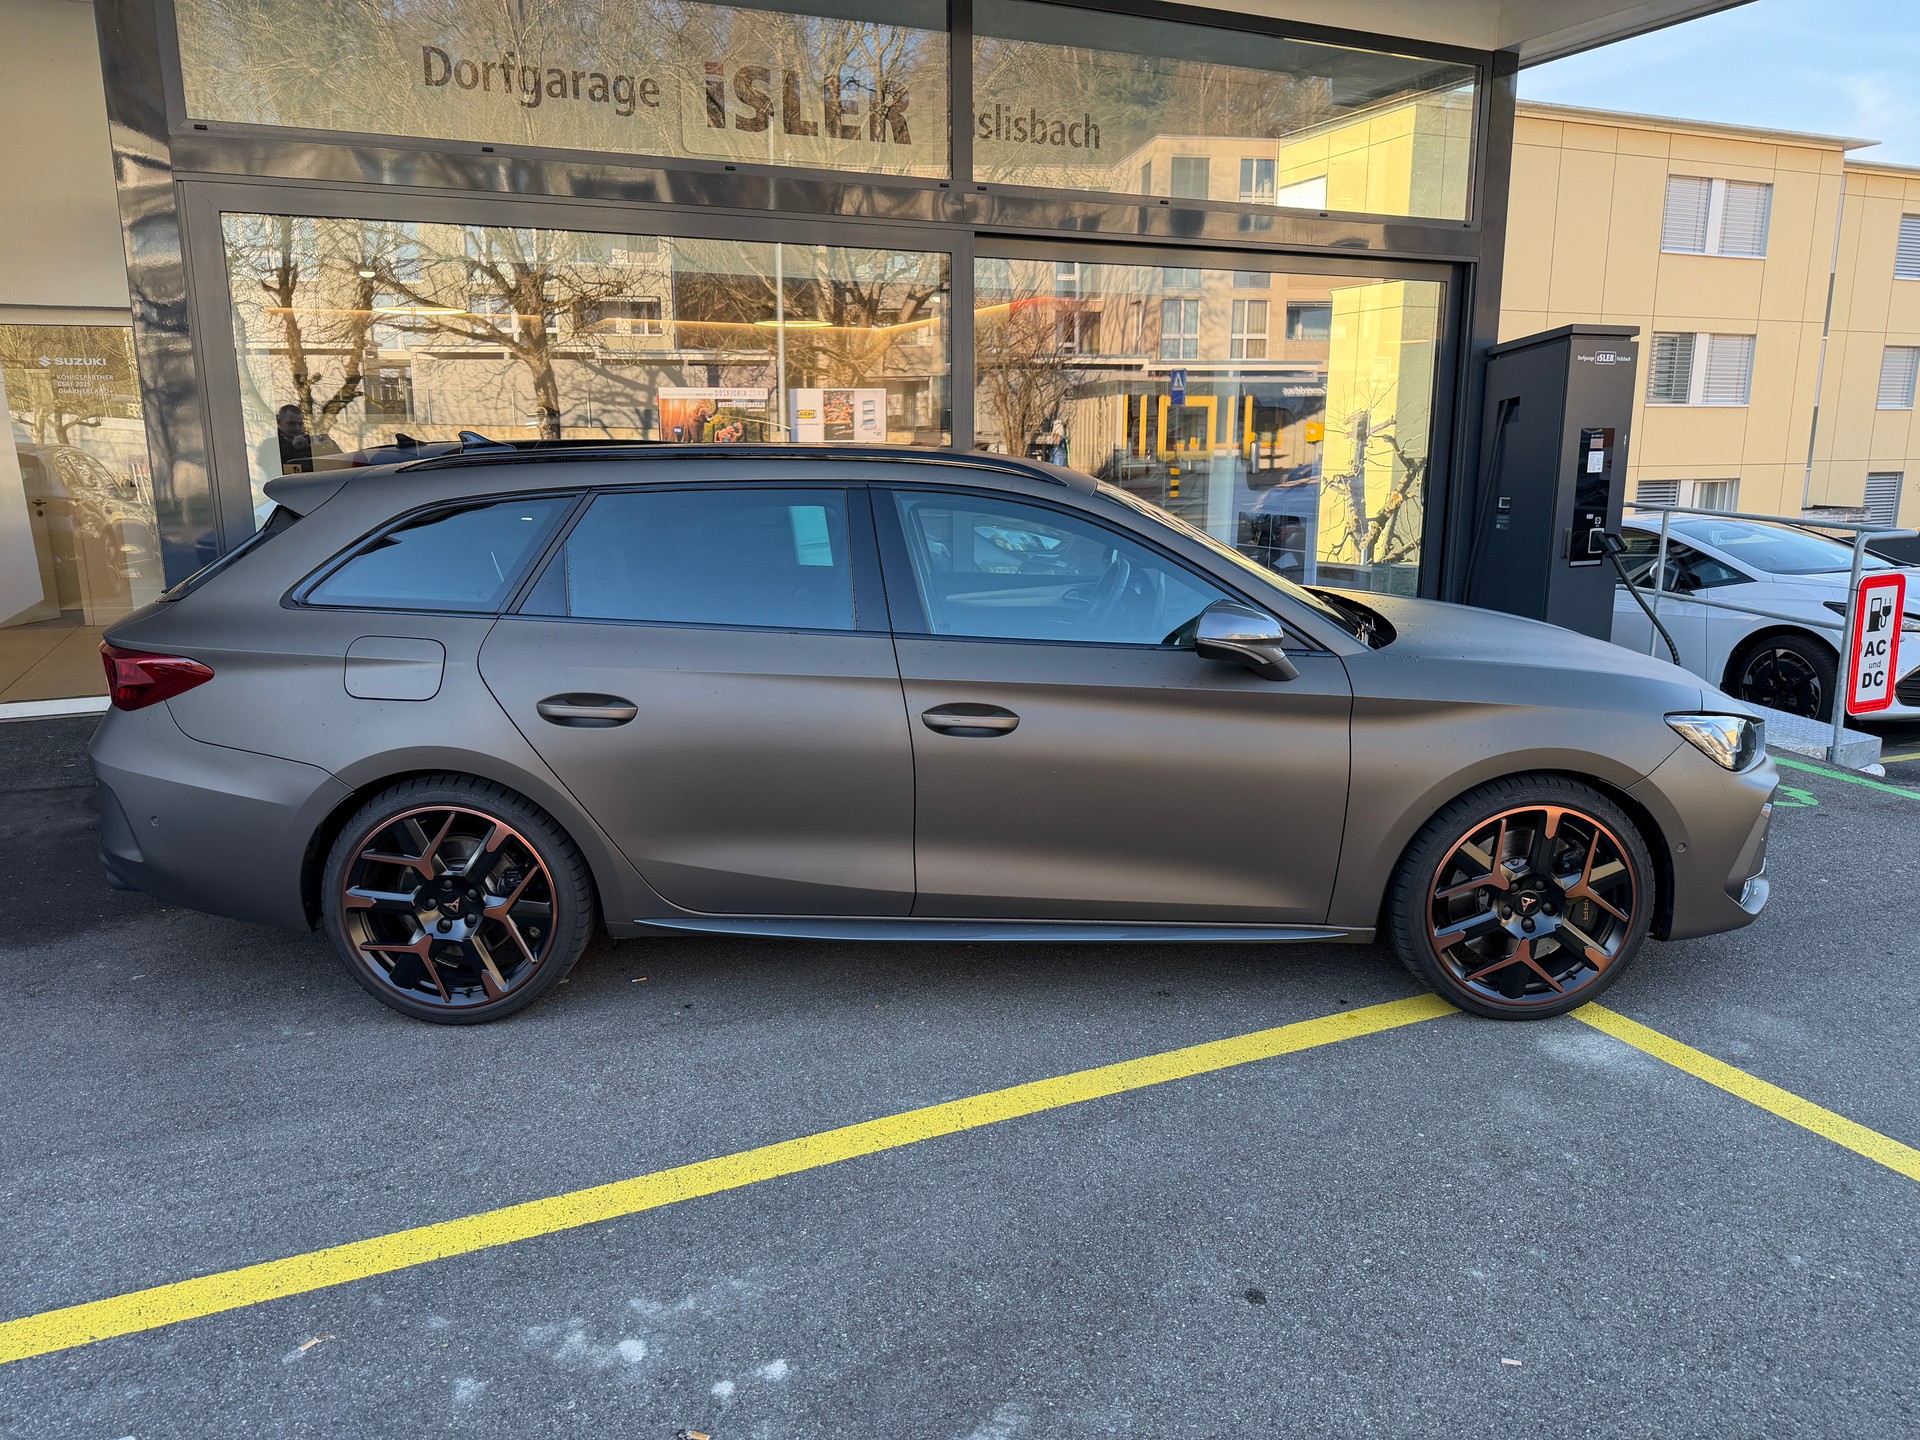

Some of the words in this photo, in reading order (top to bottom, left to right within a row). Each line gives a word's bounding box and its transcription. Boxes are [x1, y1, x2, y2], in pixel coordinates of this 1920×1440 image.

[422, 45, 660, 117] Dorfgarage
[973, 102, 1100, 149] slisbach
[55, 357, 107, 366] SUZUKI
[1864, 639, 1886, 657] AC
[1869, 660, 1882, 669] und
[1862, 671, 1884, 688] DC
